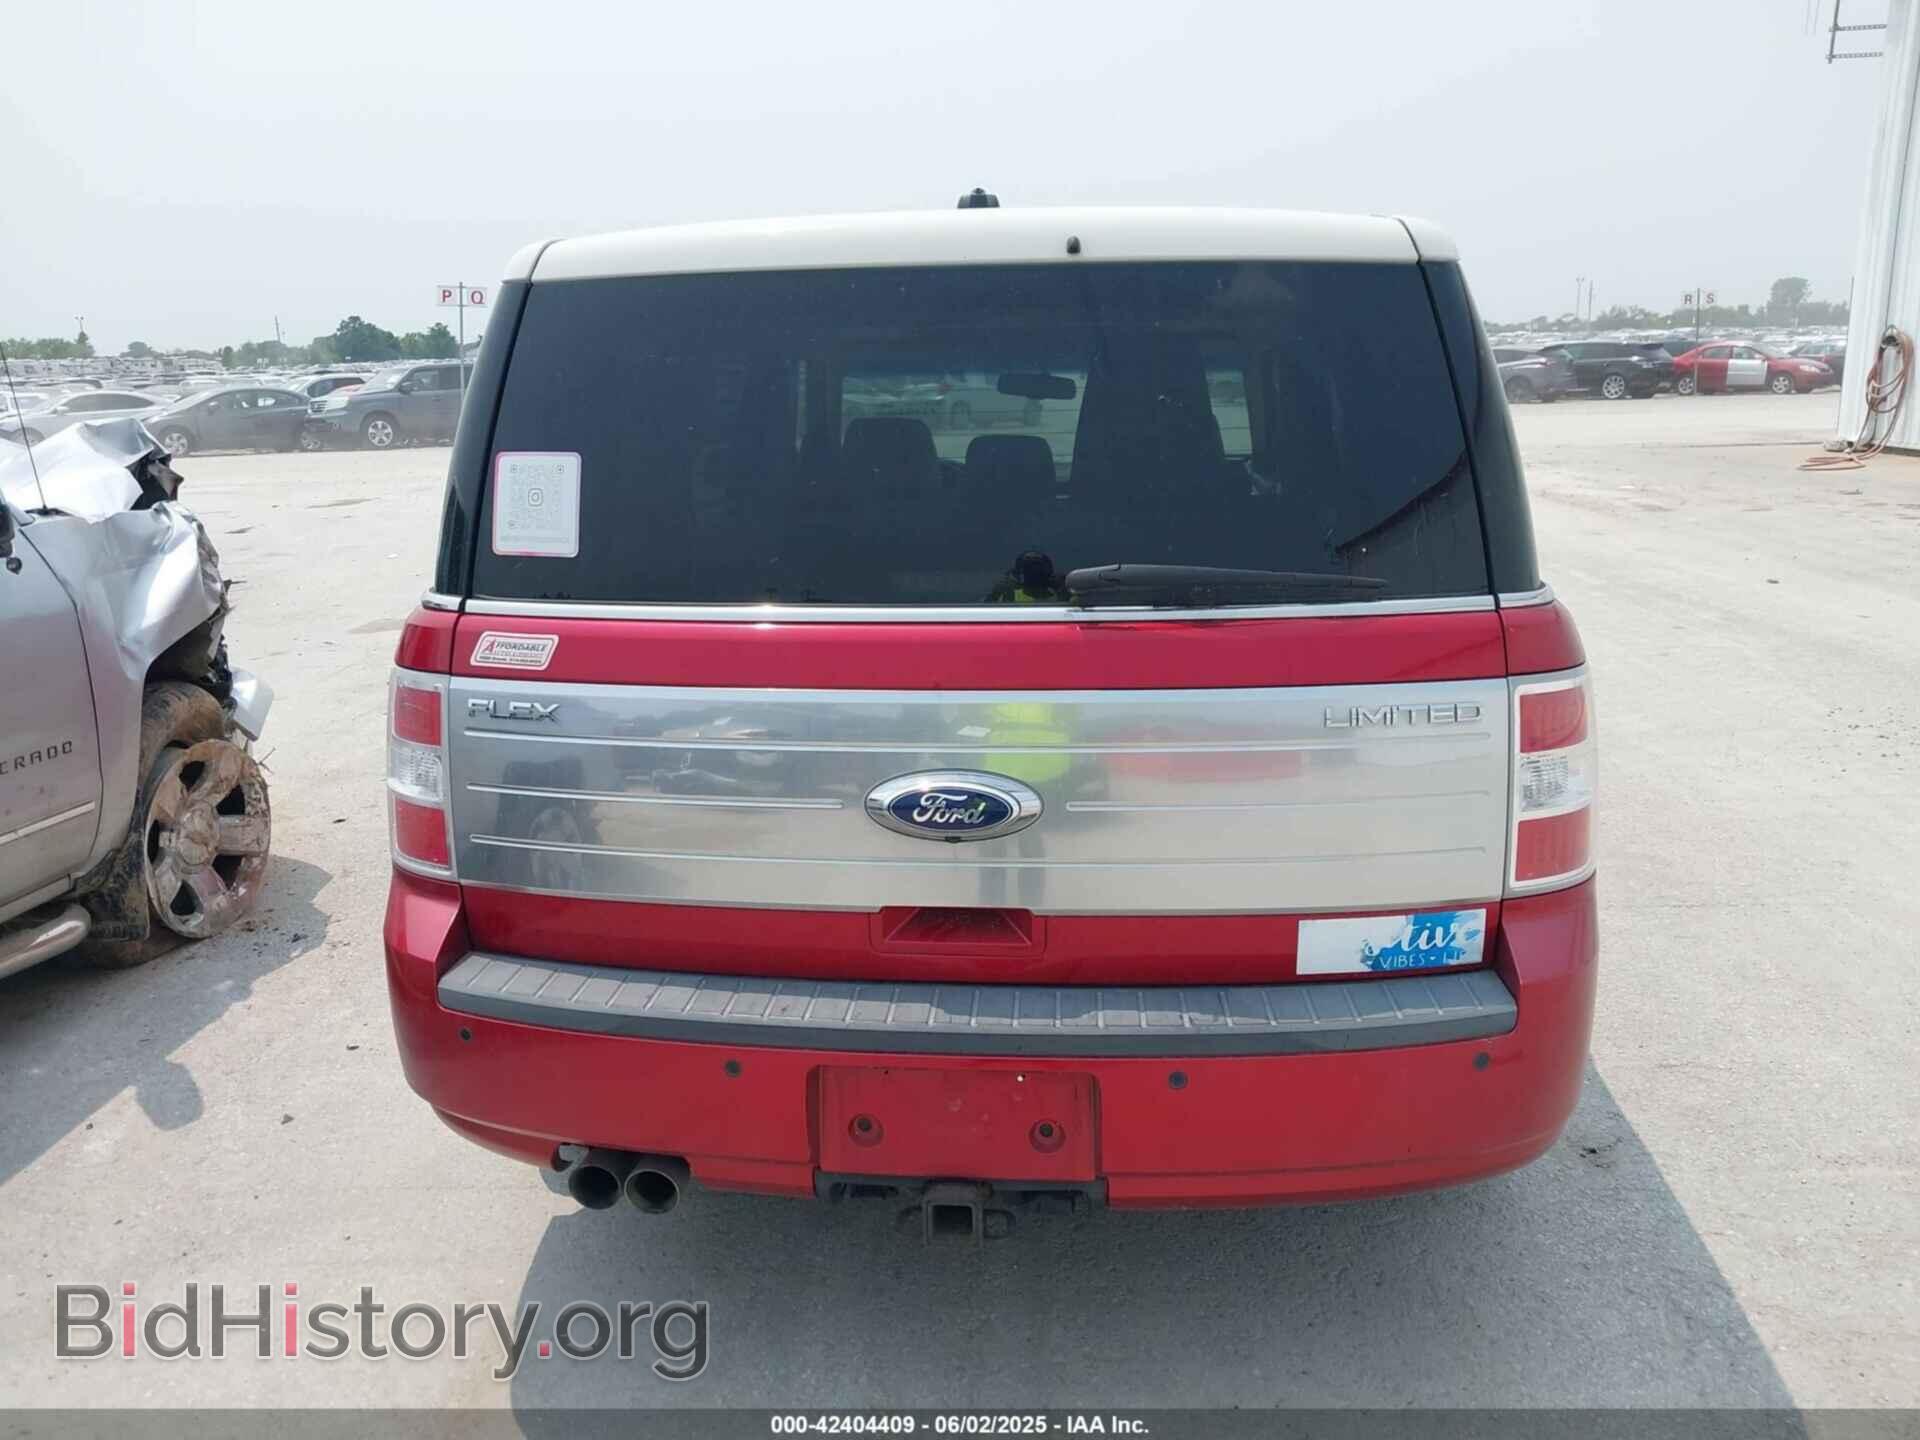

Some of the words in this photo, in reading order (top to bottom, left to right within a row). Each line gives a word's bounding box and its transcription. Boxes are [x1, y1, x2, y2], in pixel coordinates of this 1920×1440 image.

[442, 289, 452, 302] P
[471, 290, 485, 304] Q
[1684, 294, 1692, 304] R
[1706, 292, 1714, 304] S
[467, 698, 560, 721] FLEX
[1323, 701, 1482, 728] LIMITED
[912, 792, 985, 824] Ford
[1380, 953, 1426, 969] VIBES
